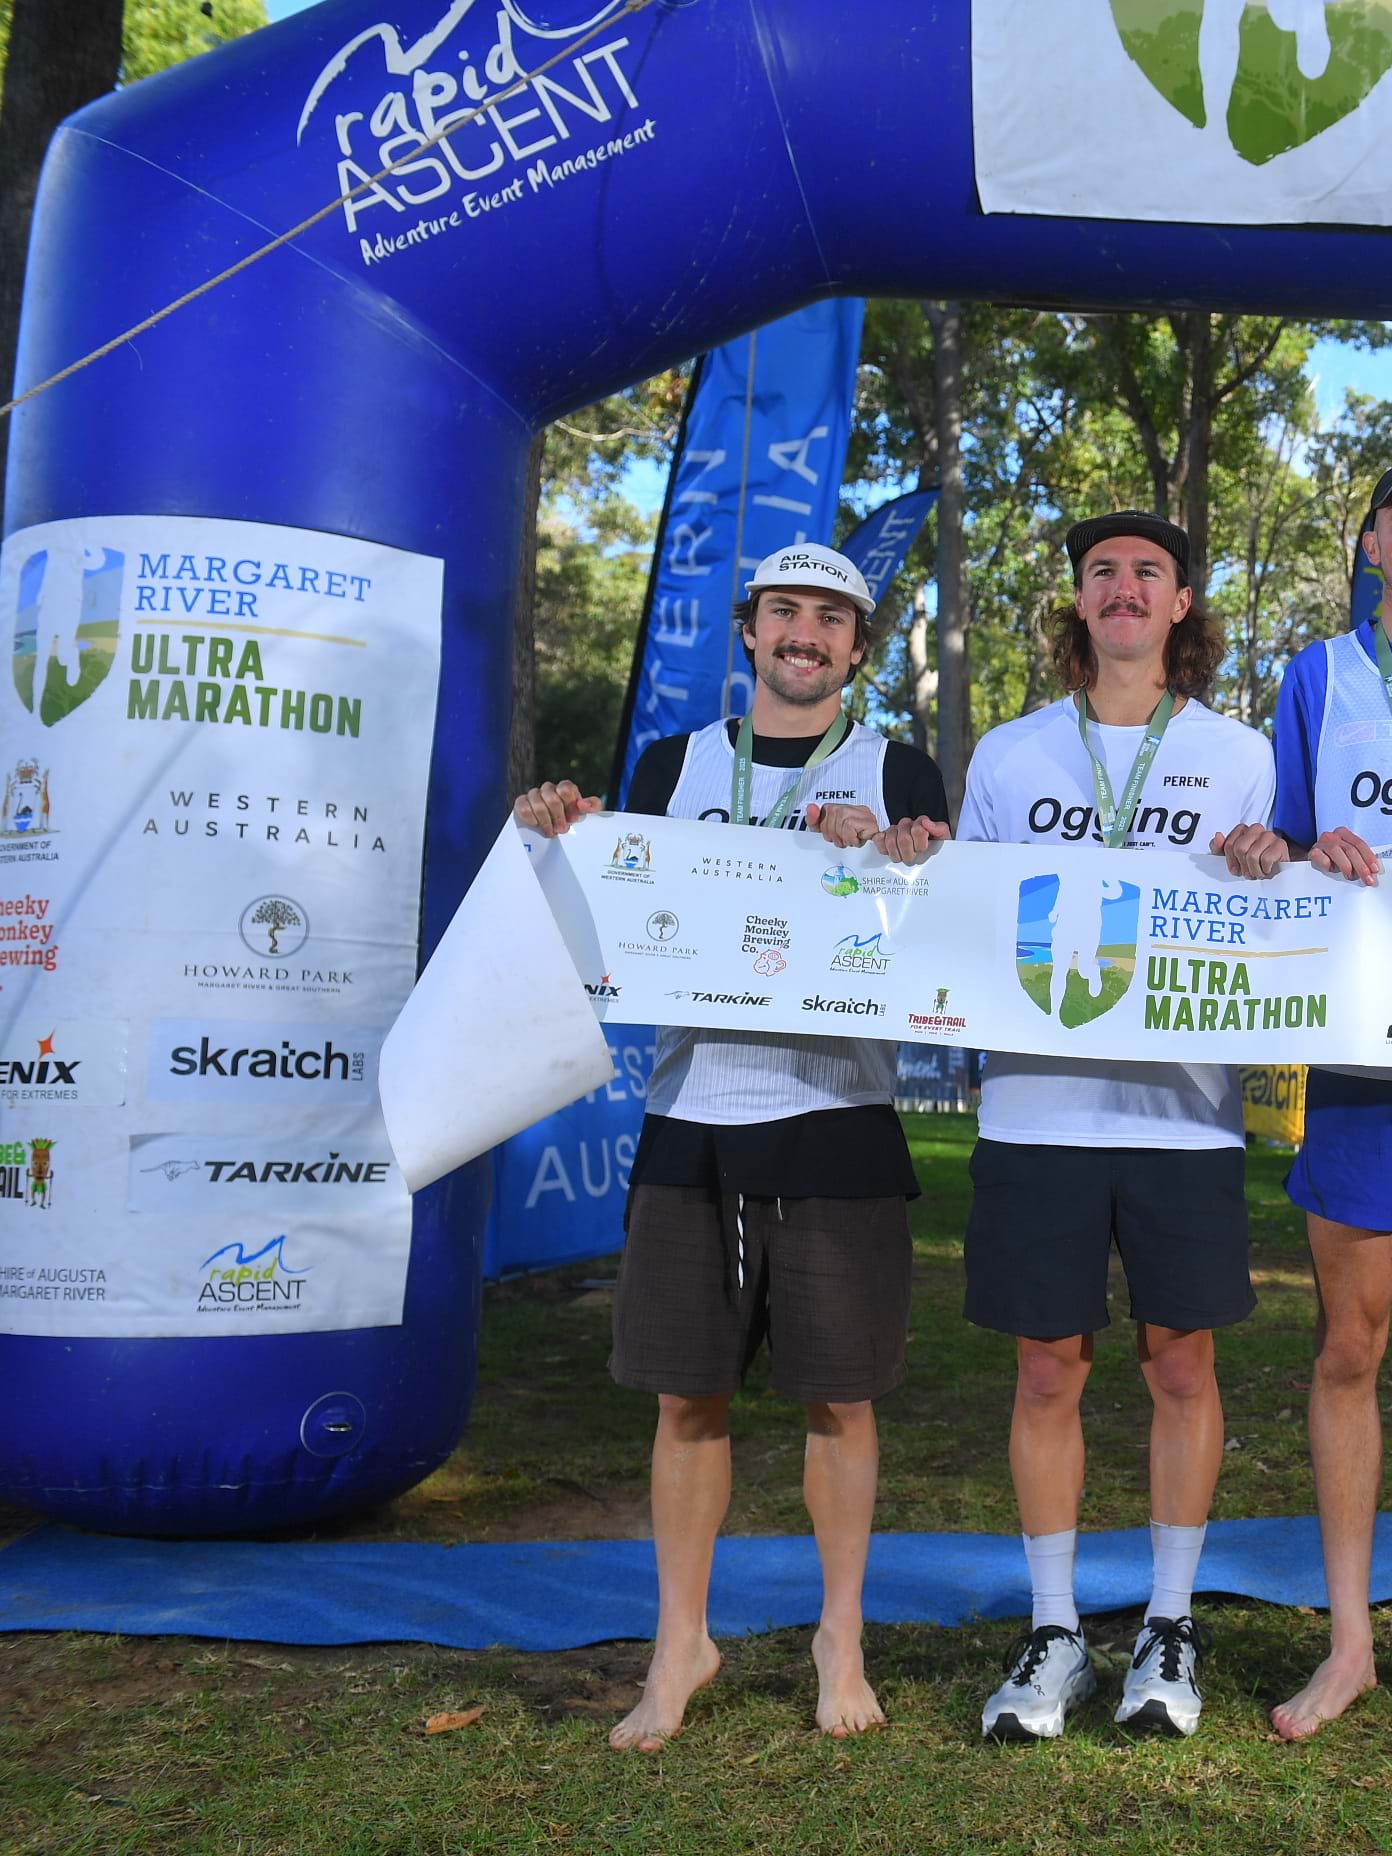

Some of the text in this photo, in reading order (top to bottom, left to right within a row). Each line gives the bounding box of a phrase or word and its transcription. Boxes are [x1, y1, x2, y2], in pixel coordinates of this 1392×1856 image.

[335, 10, 527, 156] rapid
[337, 37, 640, 233] ASCENT
[360, 118, 657, 266] Adventure Event Management
[780, 553, 810, 563] AID
[137, 553, 372, 602] MARGARET
[778, 561, 849, 584] STATION
[134, 585, 260, 618] RIVER
[130, 633, 265, 681] ULTRA
[127, 678, 362, 738] MARATHON
[1163, 775, 1211, 789] PERENE
[170, 790, 369, 822] WESTERN
[815, 790, 857, 801] PERENE
[143, 818, 386, 852] AUSTRALIA
[691, 867, 784, 883] AUSTRALIA
[702, 857, 777, 871] WESTERN
[862, 876, 886, 886] SHIRE
[1151, 887, 1332, 921] MARGARET
[744, 925, 790, 938] Monkey
[746, 915, 788, 928] Cheeky
[1149, 915, 1247, 945] RIVER
[618, 941, 667, 954] HOWARD
[672, 946, 699, 956] PARK
[741, 944, 759, 954] Co.
[743, 934, 791, 950] Brewing
[831, 954, 891, 971] ASCENT
[184, 965, 354, 984] HOWARD PARK
[1147, 955, 1251, 996] ULTRA
[691, 991, 774, 1007] TARKINE
[801, 994, 879, 1017] skratch
[1144, 993, 1327, 1032] MARATHON
[170, 1036, 365, 1082] skratch LABS
[22, 1090, 78, 1100] EXTREMES
[204, 1152, 391, 1184] TARKINE
[38, 1268, 107, 1283] AUGUSTA
[208, 1256, 279, 1286] rapid
[63, 1287, 106, 1302] RIVER
[198, 1279, 307, 1303] ASCENT
